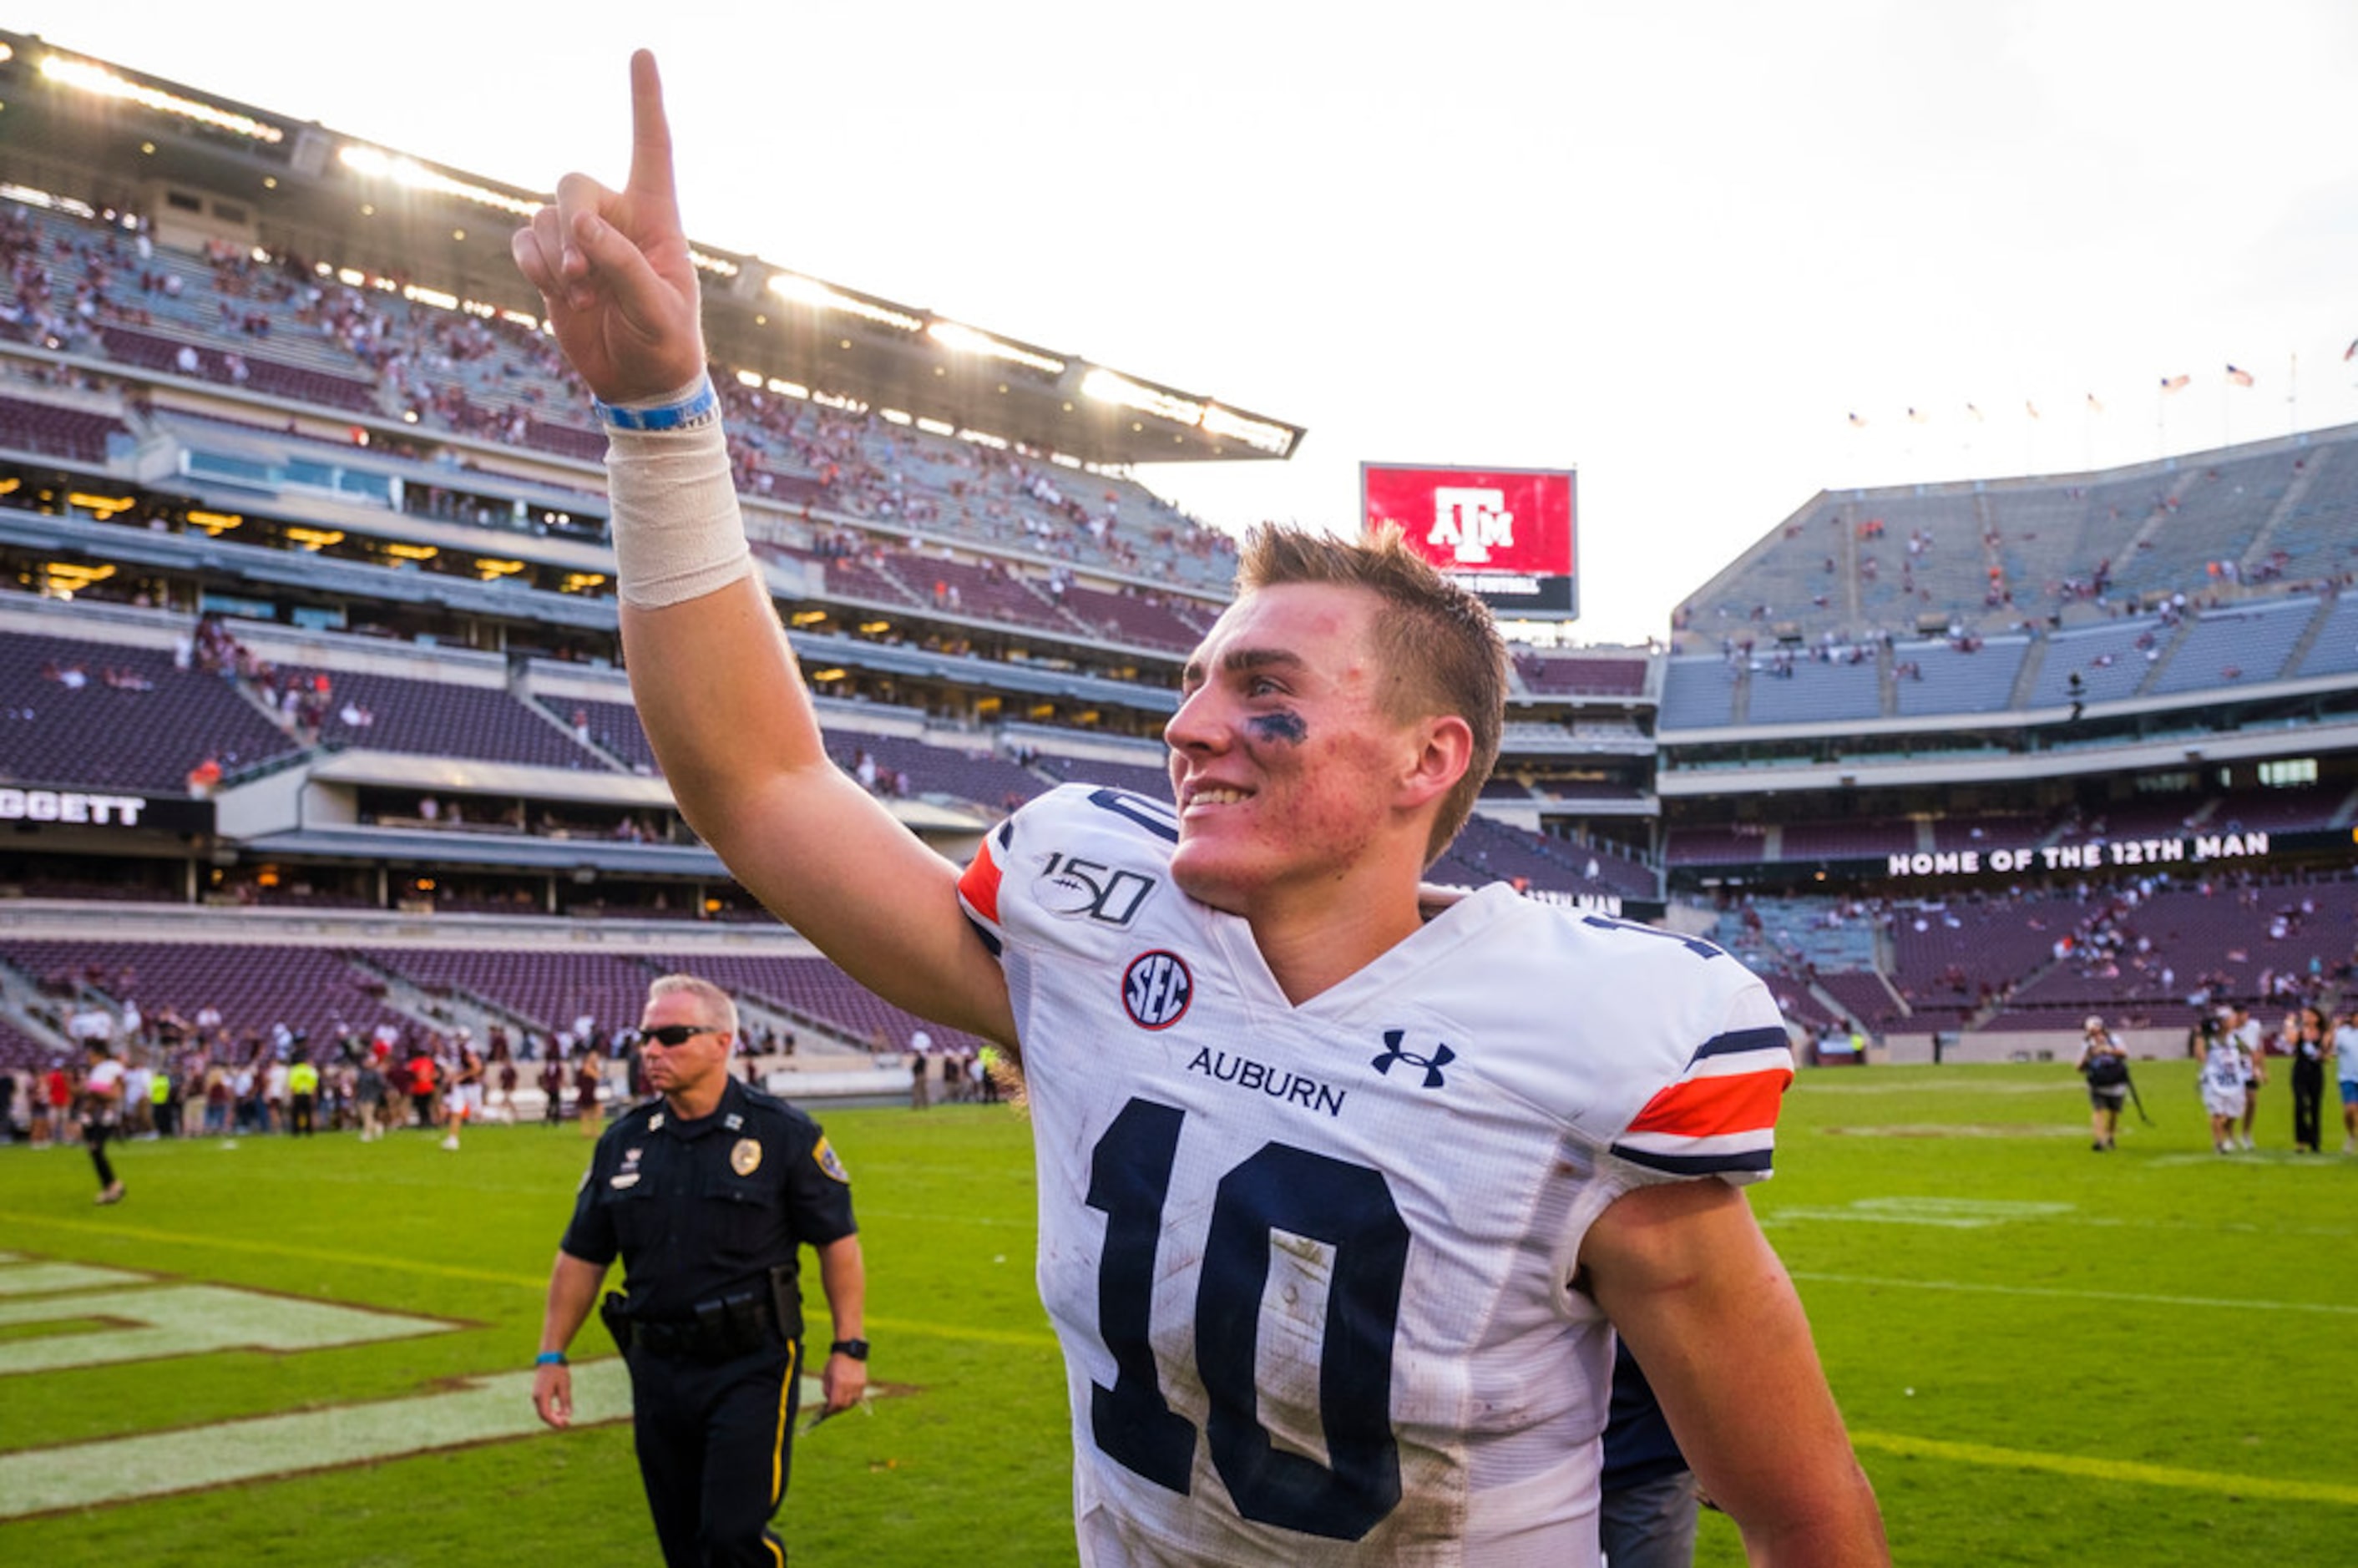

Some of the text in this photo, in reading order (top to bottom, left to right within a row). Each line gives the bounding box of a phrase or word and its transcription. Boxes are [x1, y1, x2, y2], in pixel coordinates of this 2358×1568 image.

[1040, 852, 1156, 926] 150
[1889, 832, 2269, 875] HOME OF THE 12TH MAN
[1127, 953, 1188, 1024] SEC
[1187, 1047, 1347, 1117] AUBURN
[1085, 1096, 1411, 1542] 10
